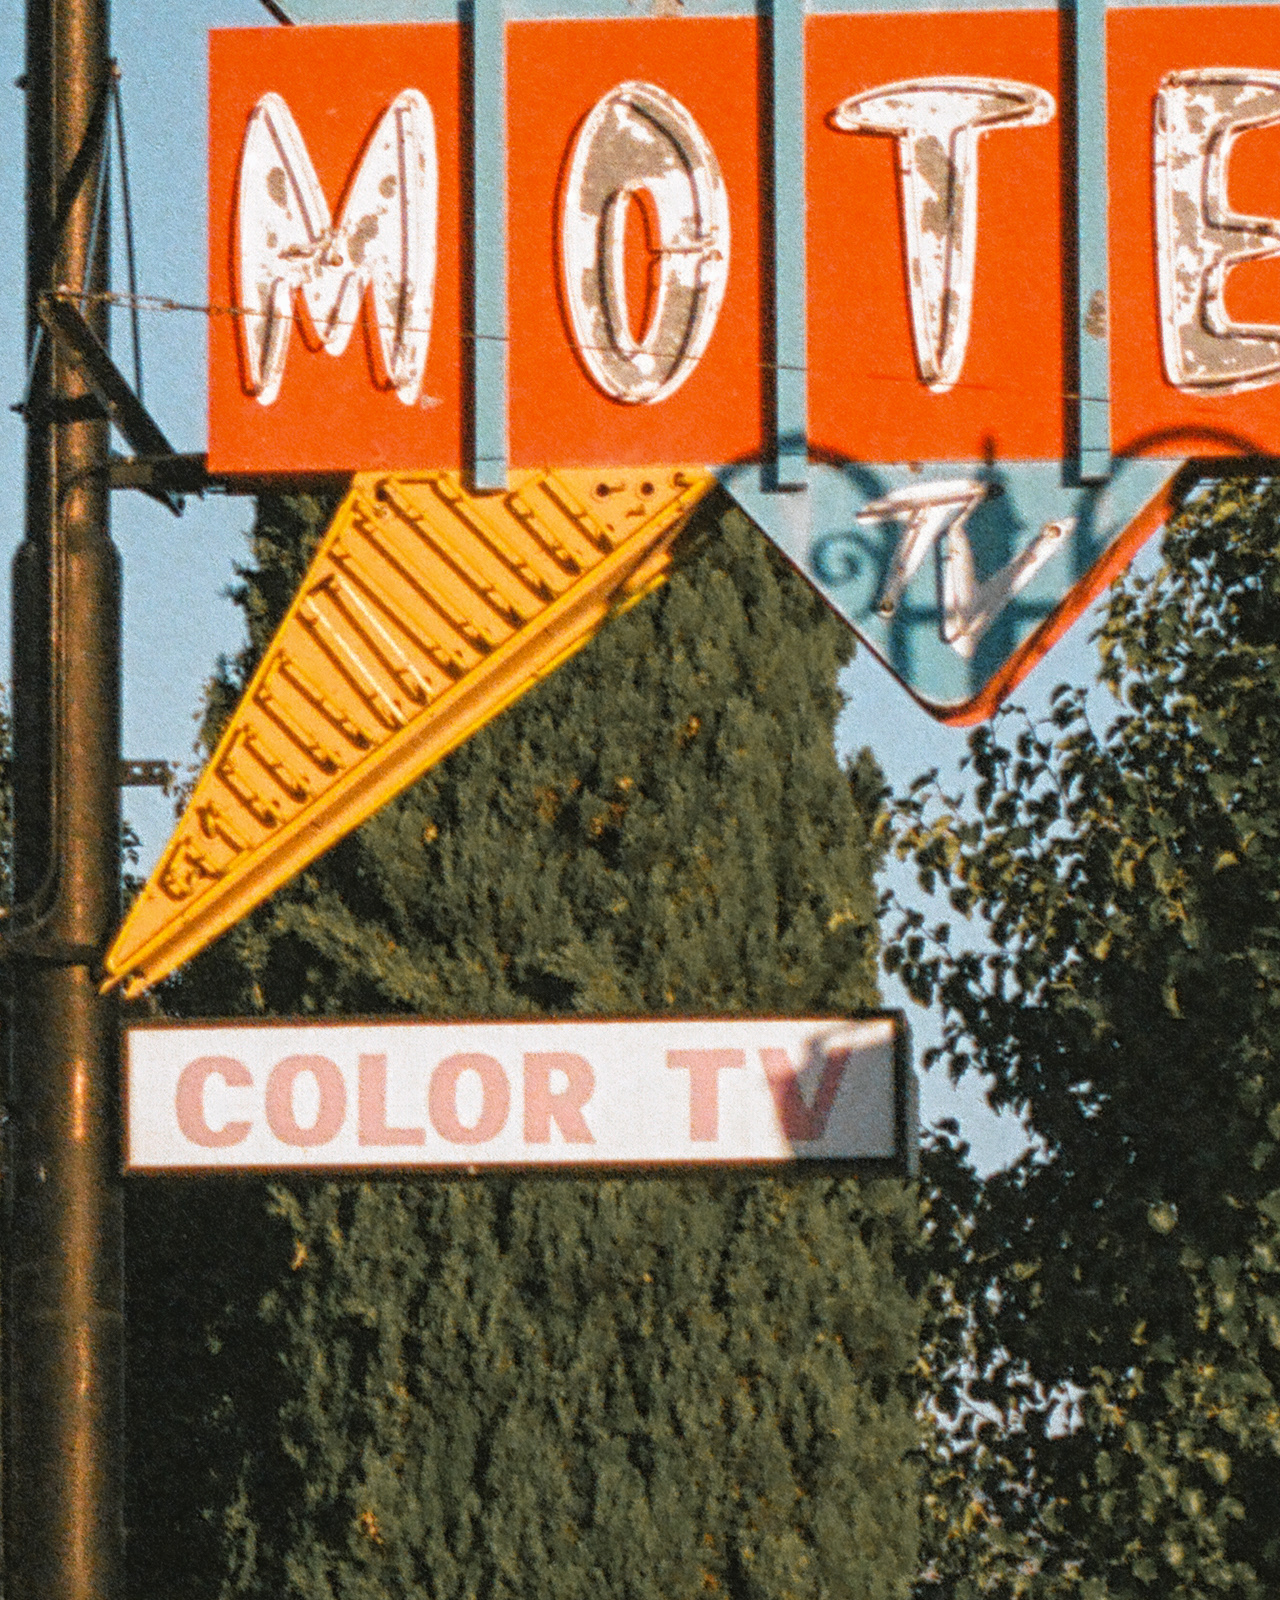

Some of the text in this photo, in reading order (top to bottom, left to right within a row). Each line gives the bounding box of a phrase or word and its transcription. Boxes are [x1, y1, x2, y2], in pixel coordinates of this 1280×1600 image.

[856, 480, 1078, 658] TV
[174, 1047, 853, 1149] COLOR TV
